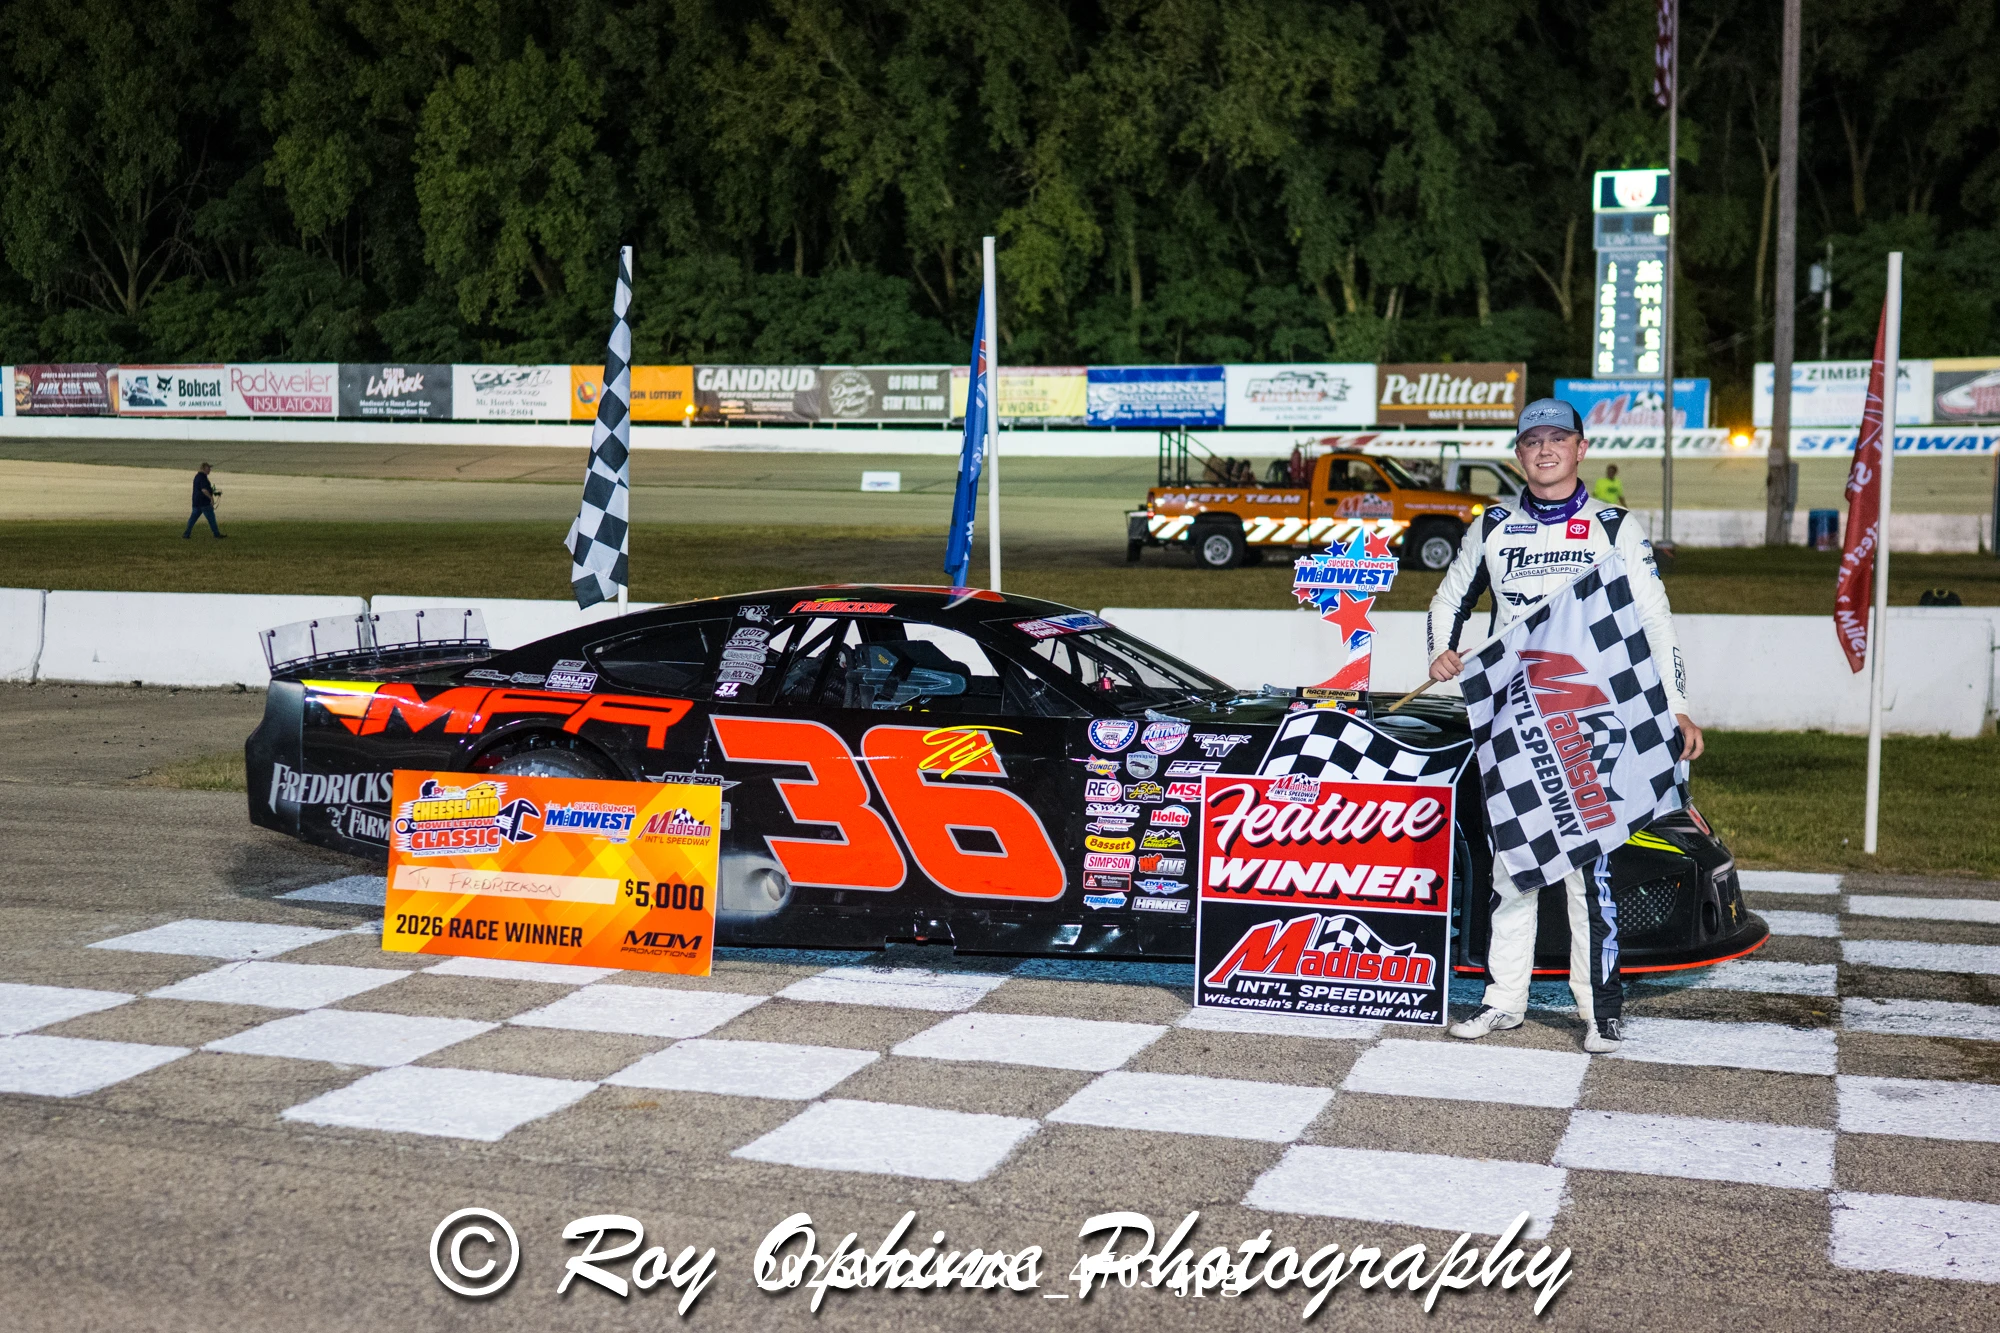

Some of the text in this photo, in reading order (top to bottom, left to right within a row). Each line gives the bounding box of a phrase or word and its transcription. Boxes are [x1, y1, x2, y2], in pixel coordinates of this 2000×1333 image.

[697, 368, 816, 391] GANDRUD
[1808, 367, 1910, 380] ZIMBRK
[36, 382, 104, 395] PARK SIDE PUB
[178, 379, 222, 398] Bobcat
[231, 368, 333, 396] Rockweiler
[1381, 370, 1516, 405] Pellitteri
[649, 391, 683, 400] LOTTERY
[253, 396, 323, 411] INSULATION
[1427, 410, 1463, 420] WASTE
[1466, 410, 1515, 420] SYSTEMS
[1797, 436, 1999, 451] SPDWAY
[1162, 493, 1301, 505] SAFETY TEAM
[1327, 559, 1395, 570] SUCKER PUNCH
[1499, 547, 1595, 583] Herman's
[1511, 567, 1549, 578] LANDSCAPE
[737, 605, 770, 616] FOX
[788, 600, 898, 614] FREDRICKSON
[721, 661, 763, 671] LEFTHANDER
[551, 674, 594, 683] QUALITY
[730, 670, 757, 680] ROLTEK
[1193, 734, 1252, 743] TRACK
[1515, 649, 1617, 836] Madison
[918, 725, 1024, 780] Ty
[1205, 743, 1238, 757] TV
[1508, 670, 1583, 839] INT'L SPEEDWAY
[1169, 762, 1221, 772] PFC
[664, 774, 722, 786] FIVE STAR
[1270, 775, 1318, 792] Madison
[1288, 790, 1317, 798] SPEEDWAY
[413, 798, 500, 822] CHEESELAND
[573, 802, 636, 814] SUCKER PUNCH
[709, 713, 1068, 903] 36
[1087, 803, 1140, 814] Swift
[417, 818, 495, 830] HOWIE LETTOW
[638, 809, 712, 840] Madison
[1152, 810, 1189, 827] Holley
[1207, 783, 1444, 854] Feature
[411, 827, 500, 850] CLASSIC
[645, 836, 710, 847] INT'L SPEEDWAY
[1089, 838, 1131, 850] Bassett
[1088, 856, 1132, 869] SIMPSON
[449, 872, 562, 899] FREDRICKSON
[1208, 856, 1440, 903] WINNER
[625, 879, 704, 911] $5,000
[1135, 898, 1187, 911] HAMKE
[396, 913, 583, 948] 2026 RACE WINNER
[624, 930, 704, 951] MDM
[620, 947, 697, 959] PROMOTIONS
[1204, 913, 1437, 988] Madison
[1236, 979, 1428, 1006] INT'L SPEEDWAY
[1204, 992, 1440, 1021] Wisconsin's Fastest Half Mile!
